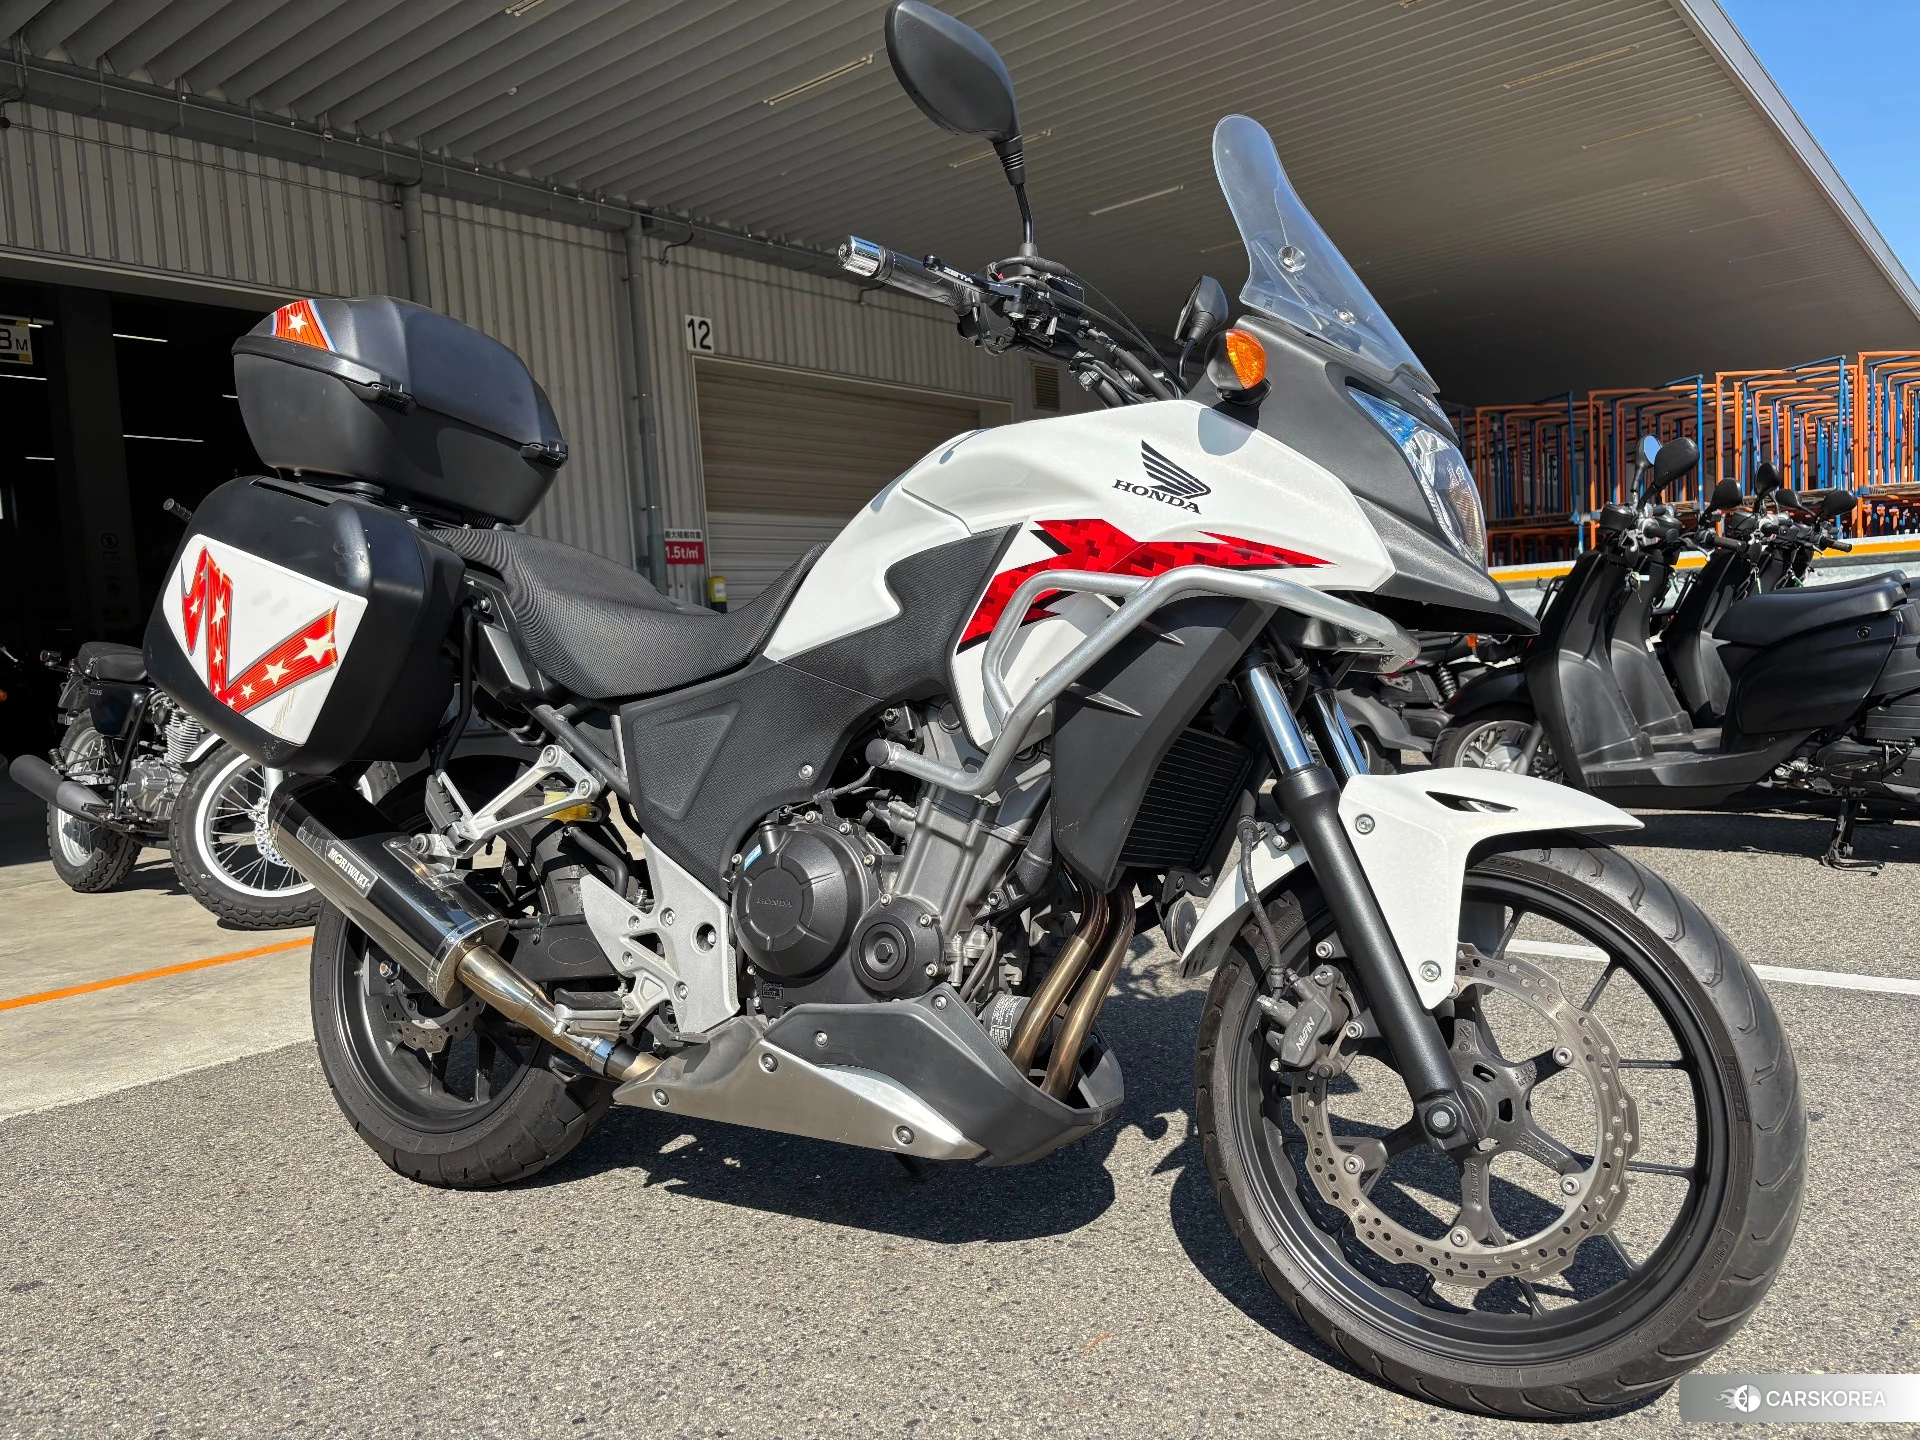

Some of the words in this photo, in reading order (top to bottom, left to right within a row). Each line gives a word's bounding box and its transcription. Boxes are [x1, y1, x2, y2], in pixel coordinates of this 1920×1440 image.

[687, 318, 712, 350] 12
[1111, 478, 1202, 515] HONDA
[327, 847, 369, 888] MORIWAKI
